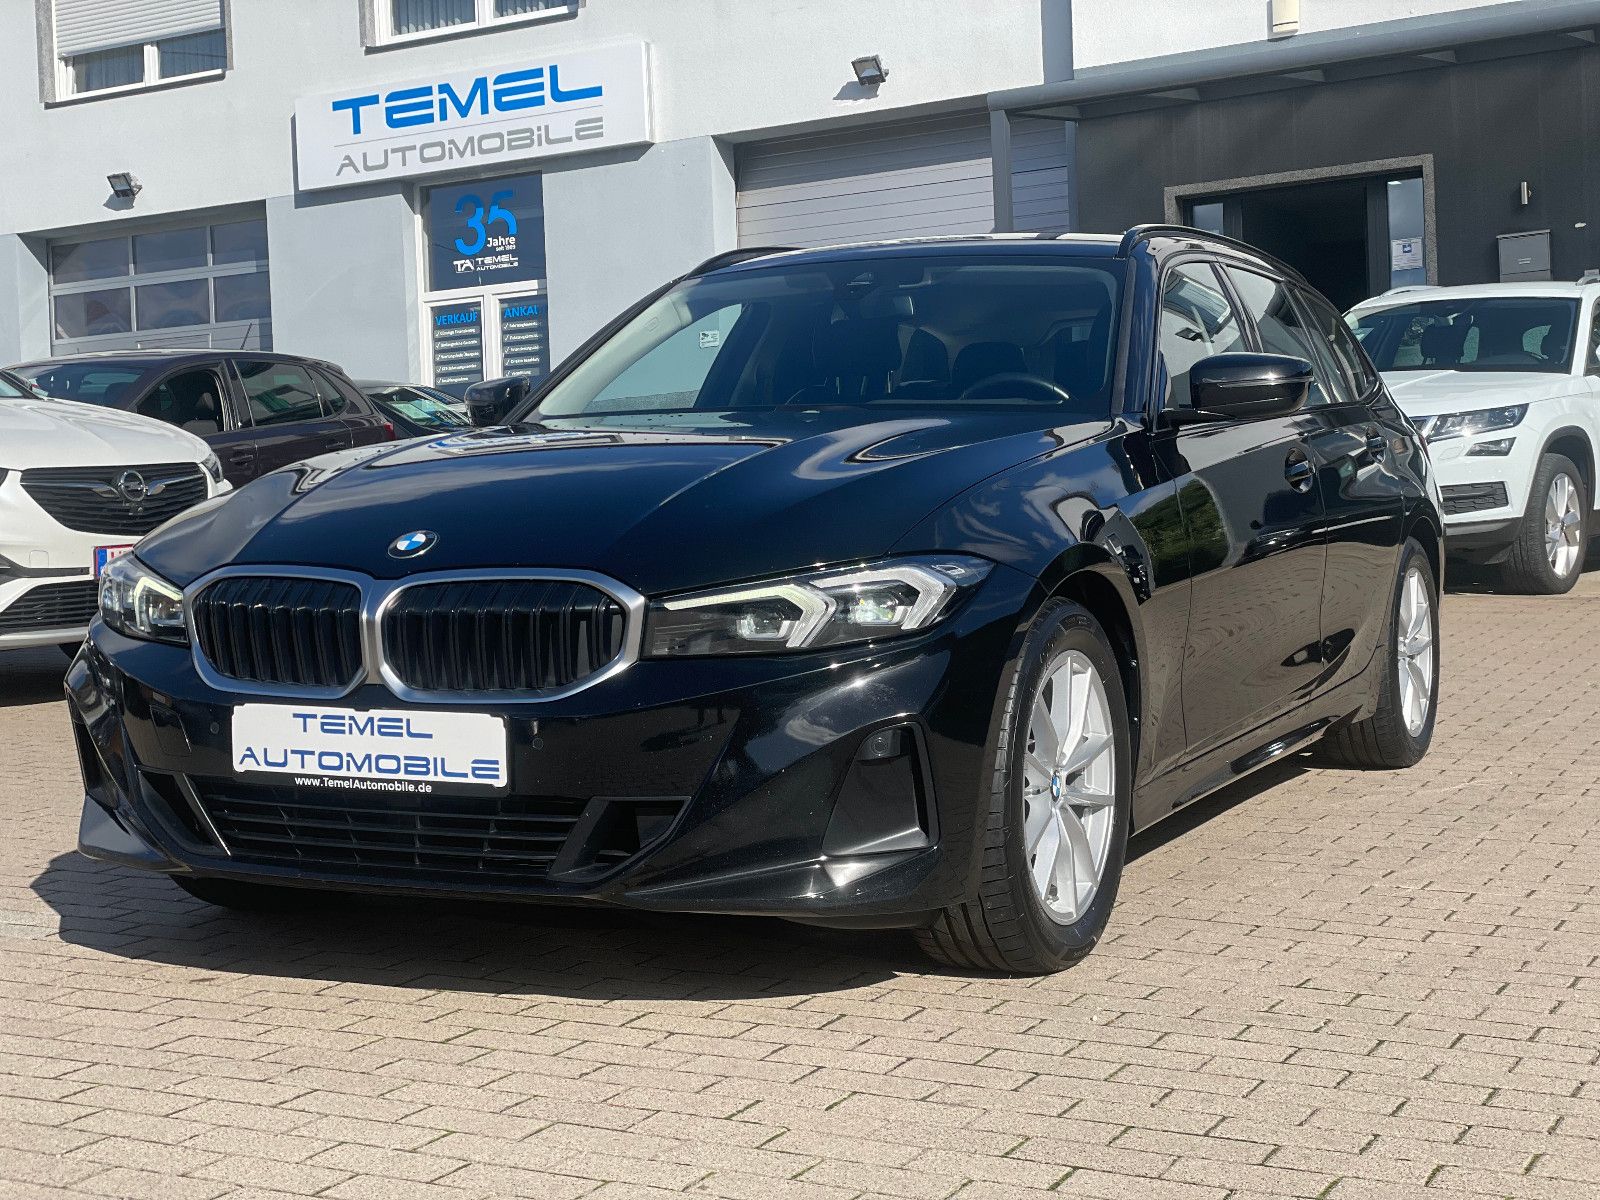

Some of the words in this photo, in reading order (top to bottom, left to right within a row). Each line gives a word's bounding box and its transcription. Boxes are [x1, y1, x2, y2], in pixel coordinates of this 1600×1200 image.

[332, 64, 603, 135] TEMEL
[454, 190, 518, 256] 35
[486, 236, 516, 248] Jahre
[475, 253, 519, 265] TEMEL
[435, 310, 478, 326] VERKAUF
[292, 713, 434, 739] TEMEL
[239, 746, 500, 780] AUTOMOBILE
[294, 776, 432, 793] www.TemelAutomobile.de
